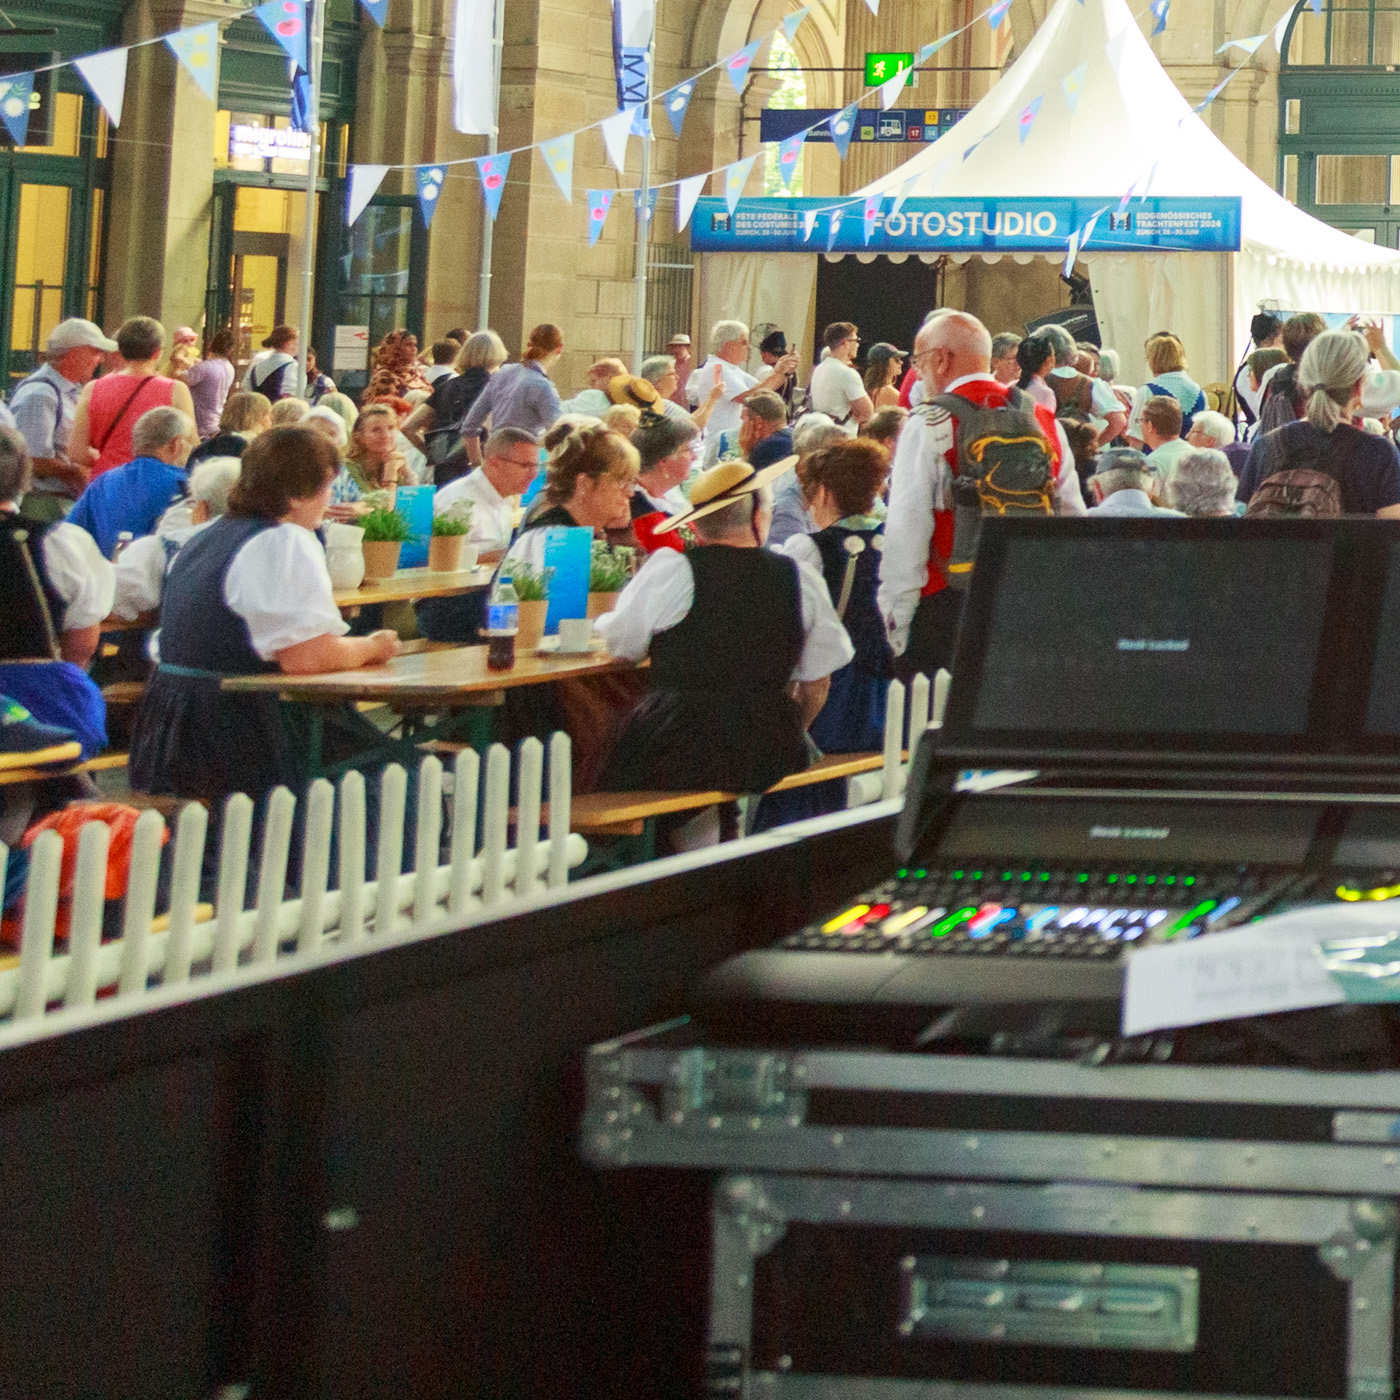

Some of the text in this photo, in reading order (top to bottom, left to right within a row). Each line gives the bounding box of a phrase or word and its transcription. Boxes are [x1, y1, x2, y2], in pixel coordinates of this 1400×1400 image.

[1136, 211, 1213, 220] EIDGENÖSSISCHES
[735, 221, 819, 229] DES COSTUMES 24
[870, 211, 1057, 237] FOTOSTUDIO
[1136, 220, 1221, 228] TRACHTENFEST 2024
